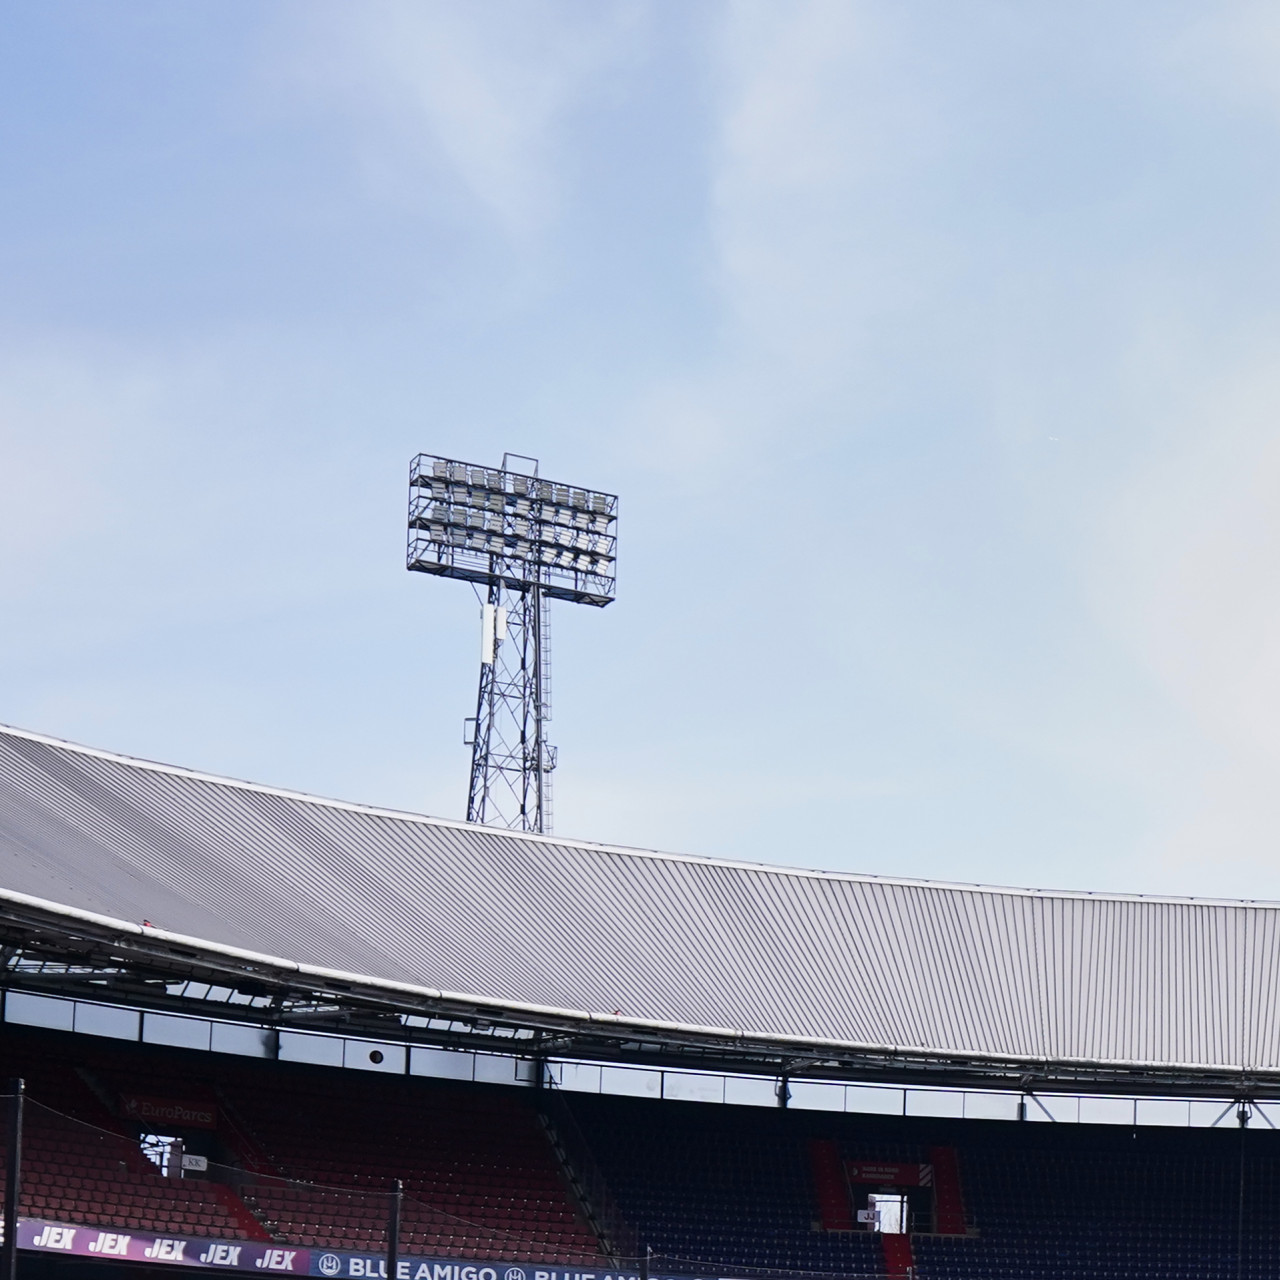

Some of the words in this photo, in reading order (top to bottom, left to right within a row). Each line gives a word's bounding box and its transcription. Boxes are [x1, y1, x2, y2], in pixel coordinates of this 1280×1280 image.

[33, 1226, 76, 1250] JEX
[88, 1232, 131, 1256] JEX
[144, 1238, 187, 1261] JEX
[200, 1244, 242, 1266] JEX
[255, 1249, 296, 1271] JEX
[349, 1258, 411, 1280] BLUE
